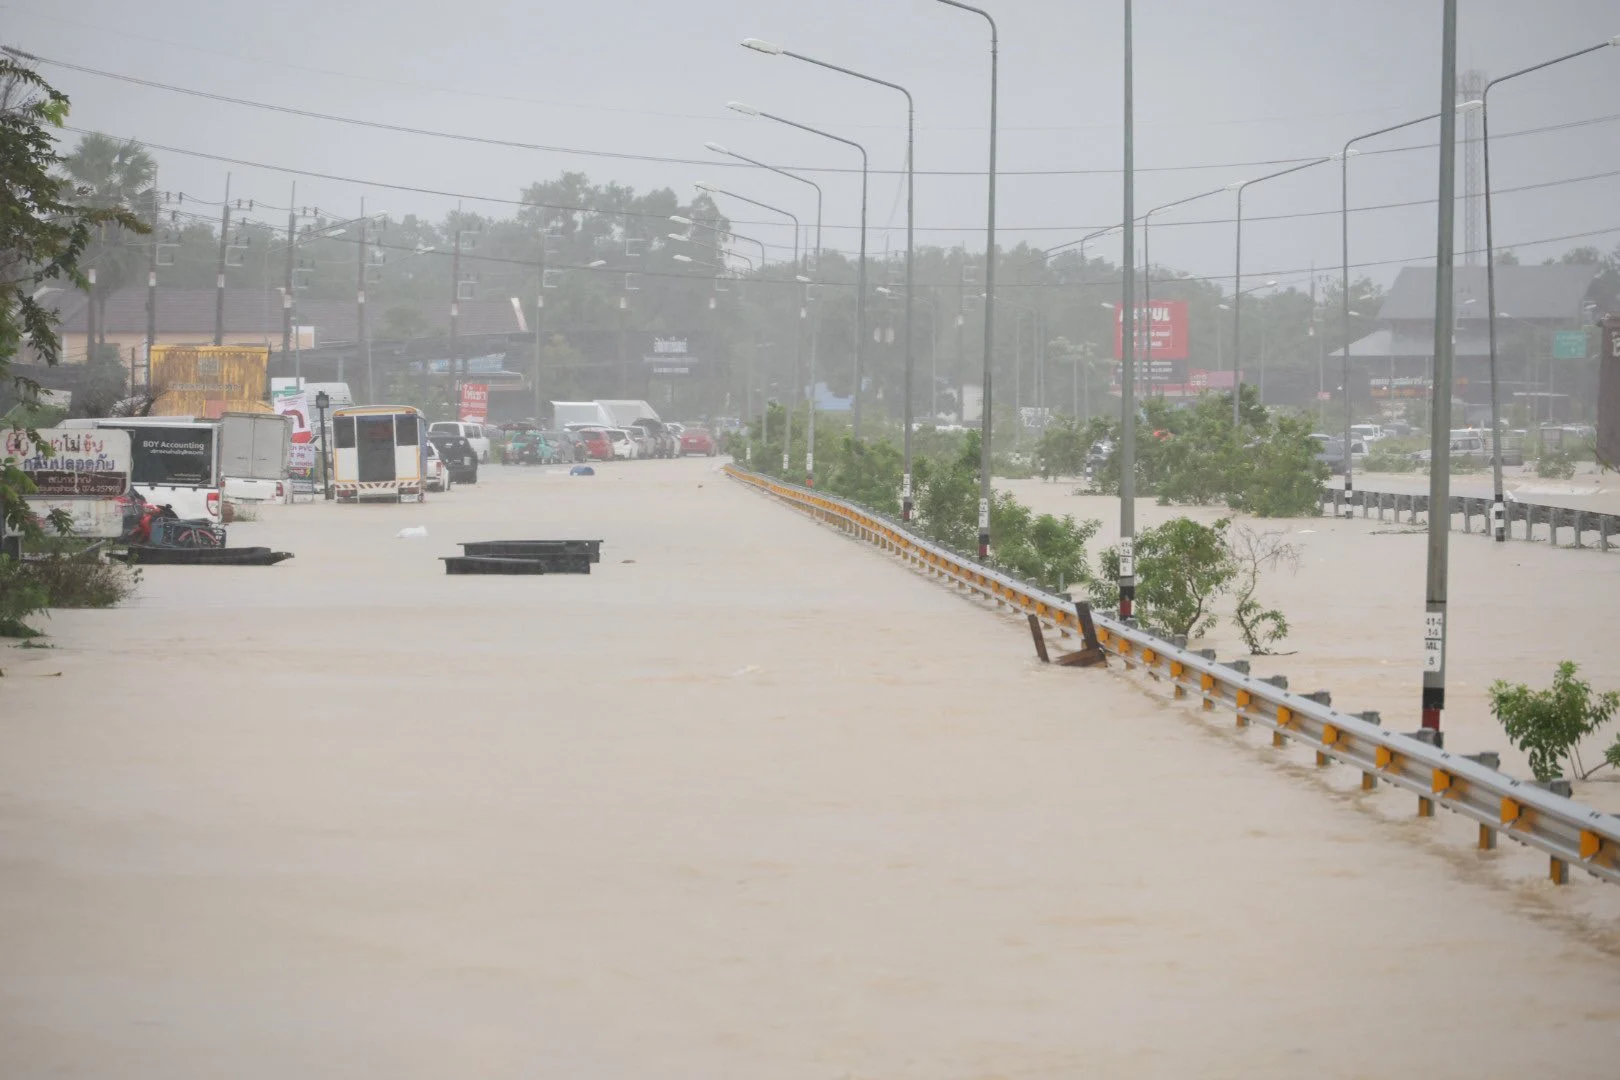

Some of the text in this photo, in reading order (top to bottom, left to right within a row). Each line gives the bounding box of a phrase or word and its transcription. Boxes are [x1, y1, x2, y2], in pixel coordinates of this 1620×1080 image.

[1119, 307, 1170, 321] TUL
[143, 440, 205, 451] BOY Accounting
